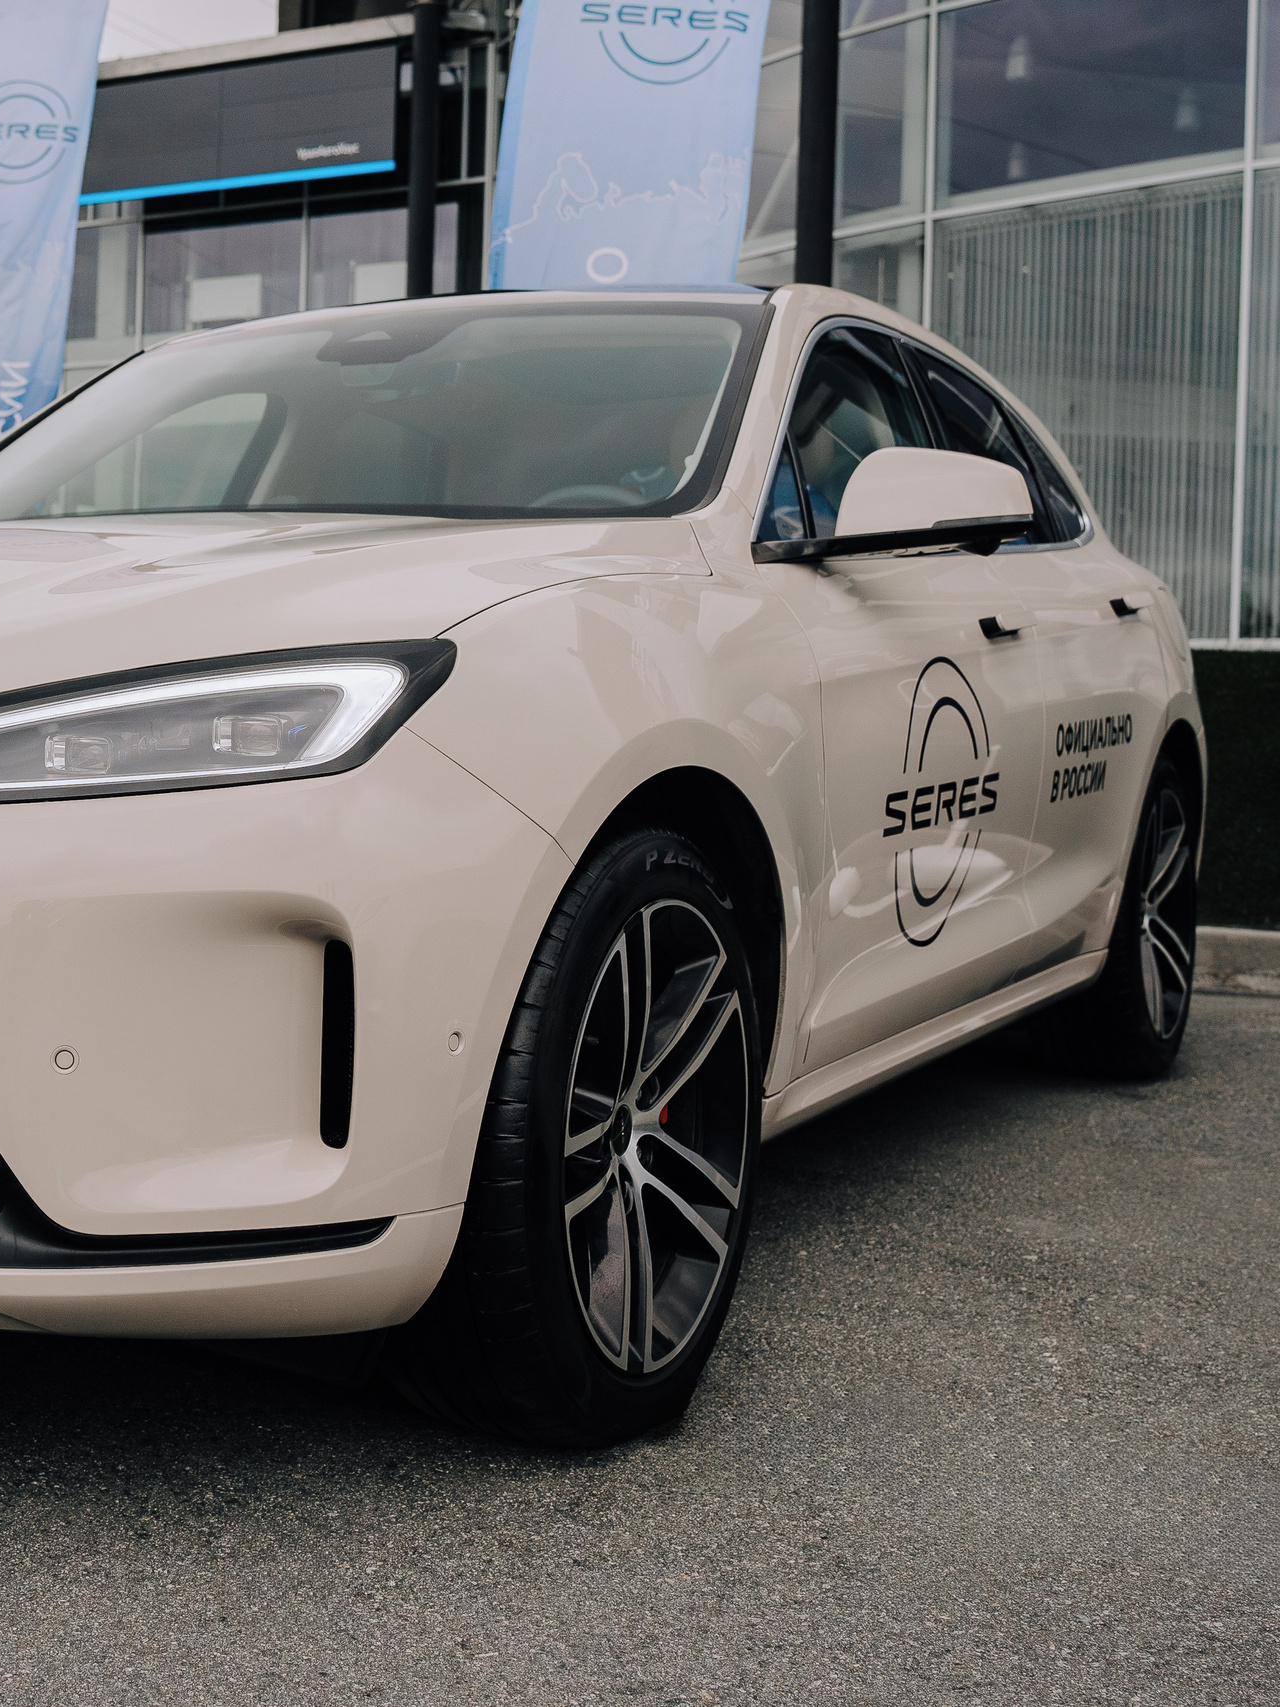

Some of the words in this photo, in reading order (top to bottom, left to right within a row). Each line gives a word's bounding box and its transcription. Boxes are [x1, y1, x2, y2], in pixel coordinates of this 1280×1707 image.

[580, 3, 750, 33] SERES
[1055, 713, 1133, 758] ОФИЦИАЛЬНО
[1050, 769, 1060, 803] В
[1060, 760, 1107, 801] РОССИИ
[882, 772, 1000, 838] SERES
